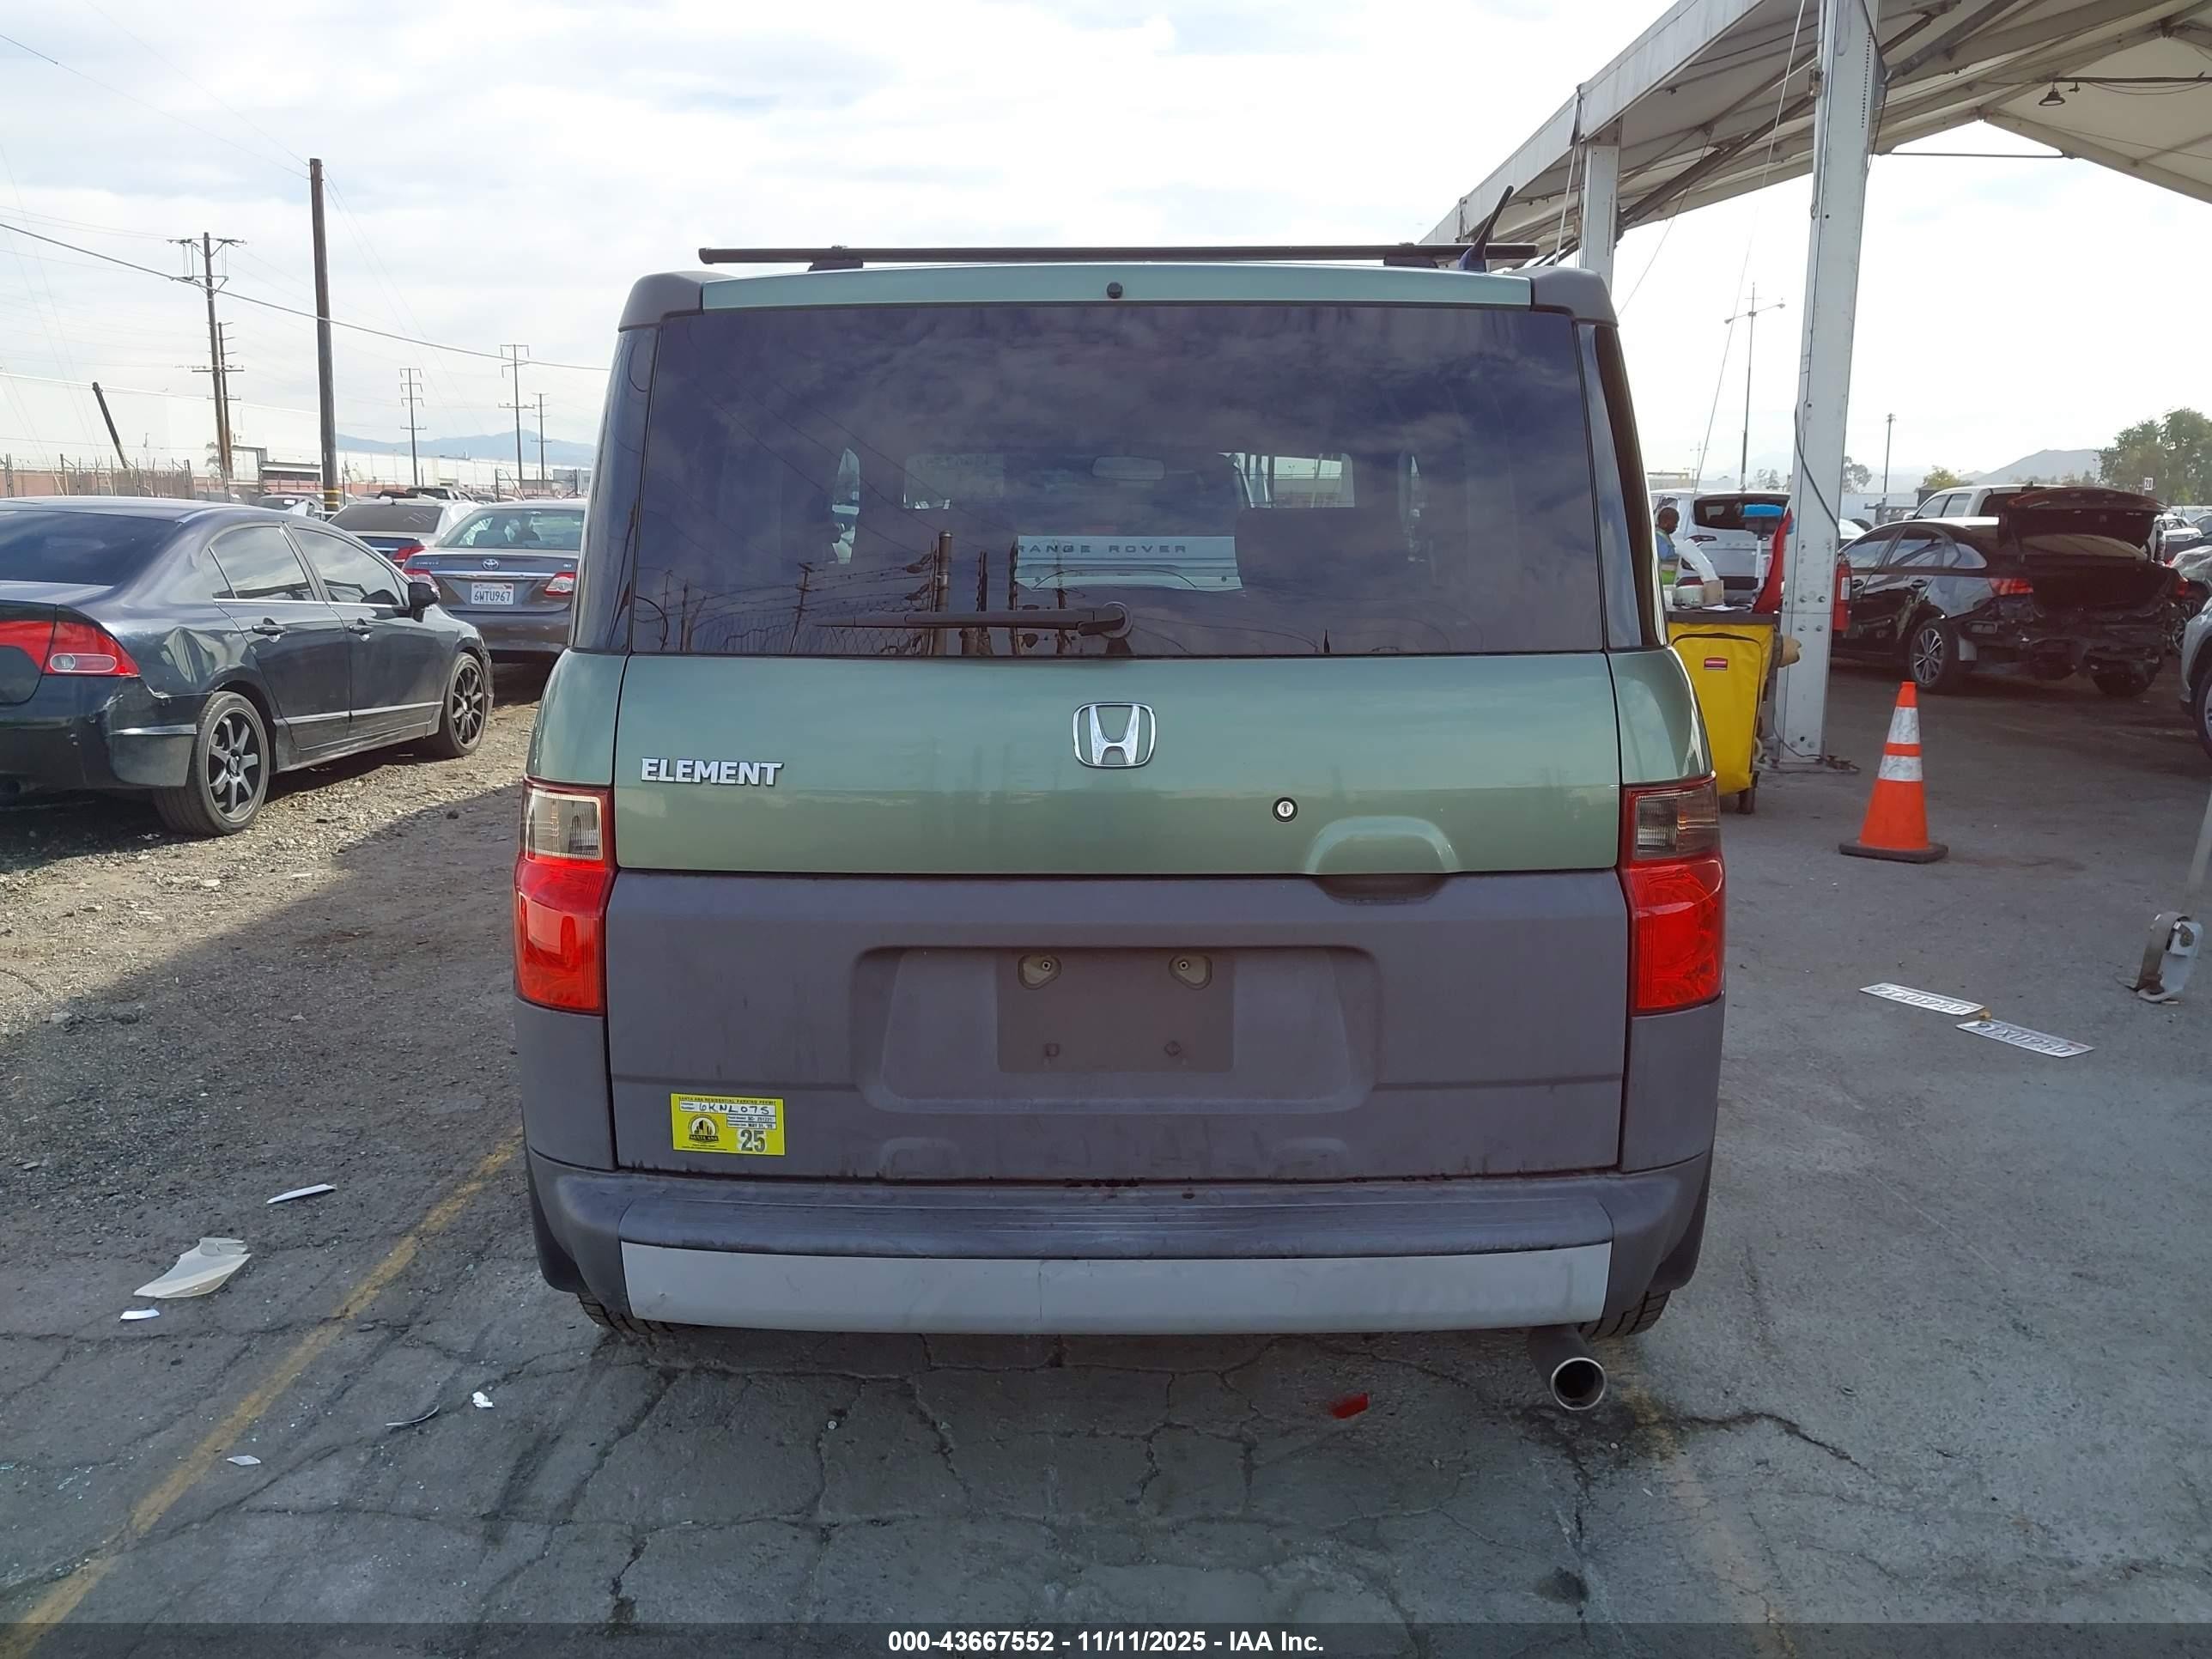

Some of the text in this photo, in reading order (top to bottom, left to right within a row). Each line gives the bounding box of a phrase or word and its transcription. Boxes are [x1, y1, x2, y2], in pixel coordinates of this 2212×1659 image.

[1109, 544, 1187, 553] ROVER
[474, 590, 511, 602] 6WTU967
[641, 757, 785, 787] ELEMENT
[740, 1129, 765, 1152] 25
